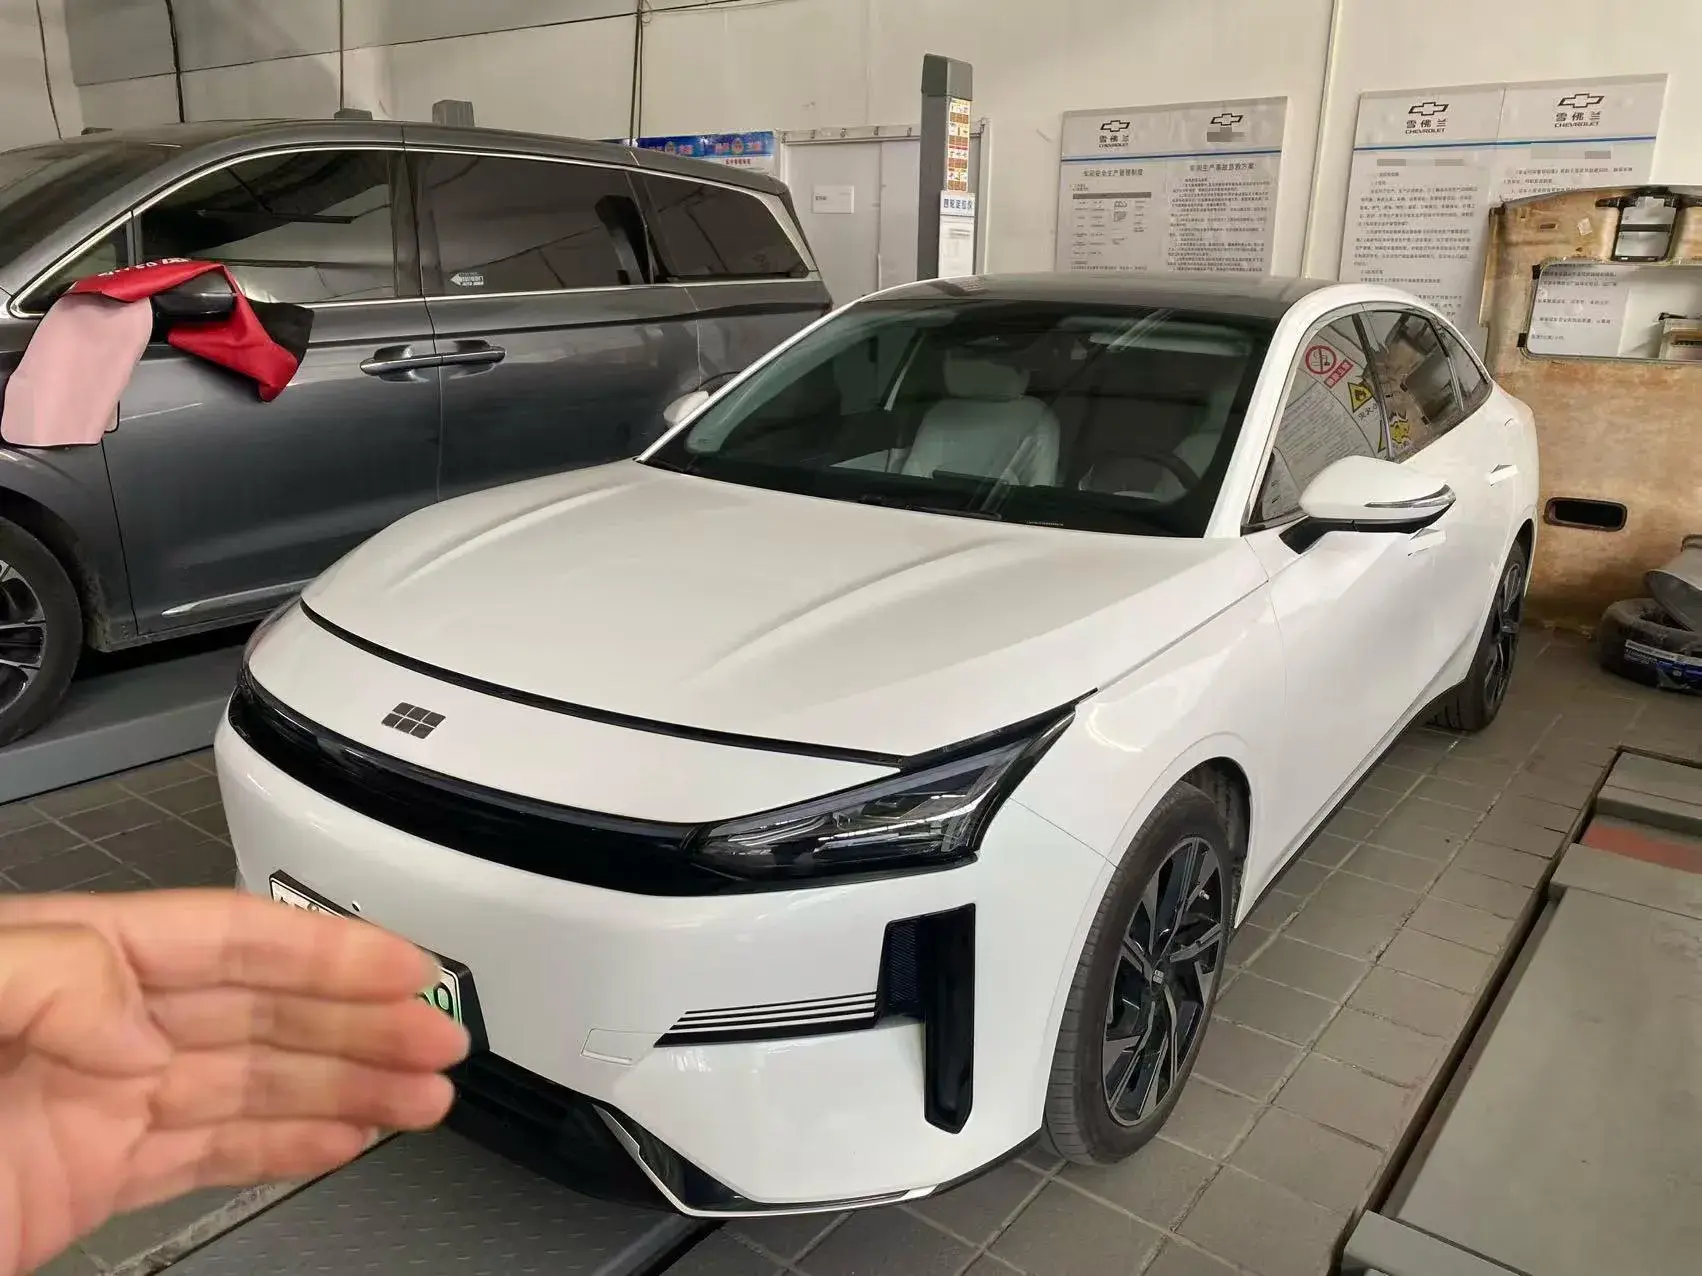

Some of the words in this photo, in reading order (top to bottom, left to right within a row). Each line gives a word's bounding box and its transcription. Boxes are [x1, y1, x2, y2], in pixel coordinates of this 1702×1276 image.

[1556, 111, 1600, 122] 雪佛兰
[1406, 118, 1447, 129] 雪佛兰
